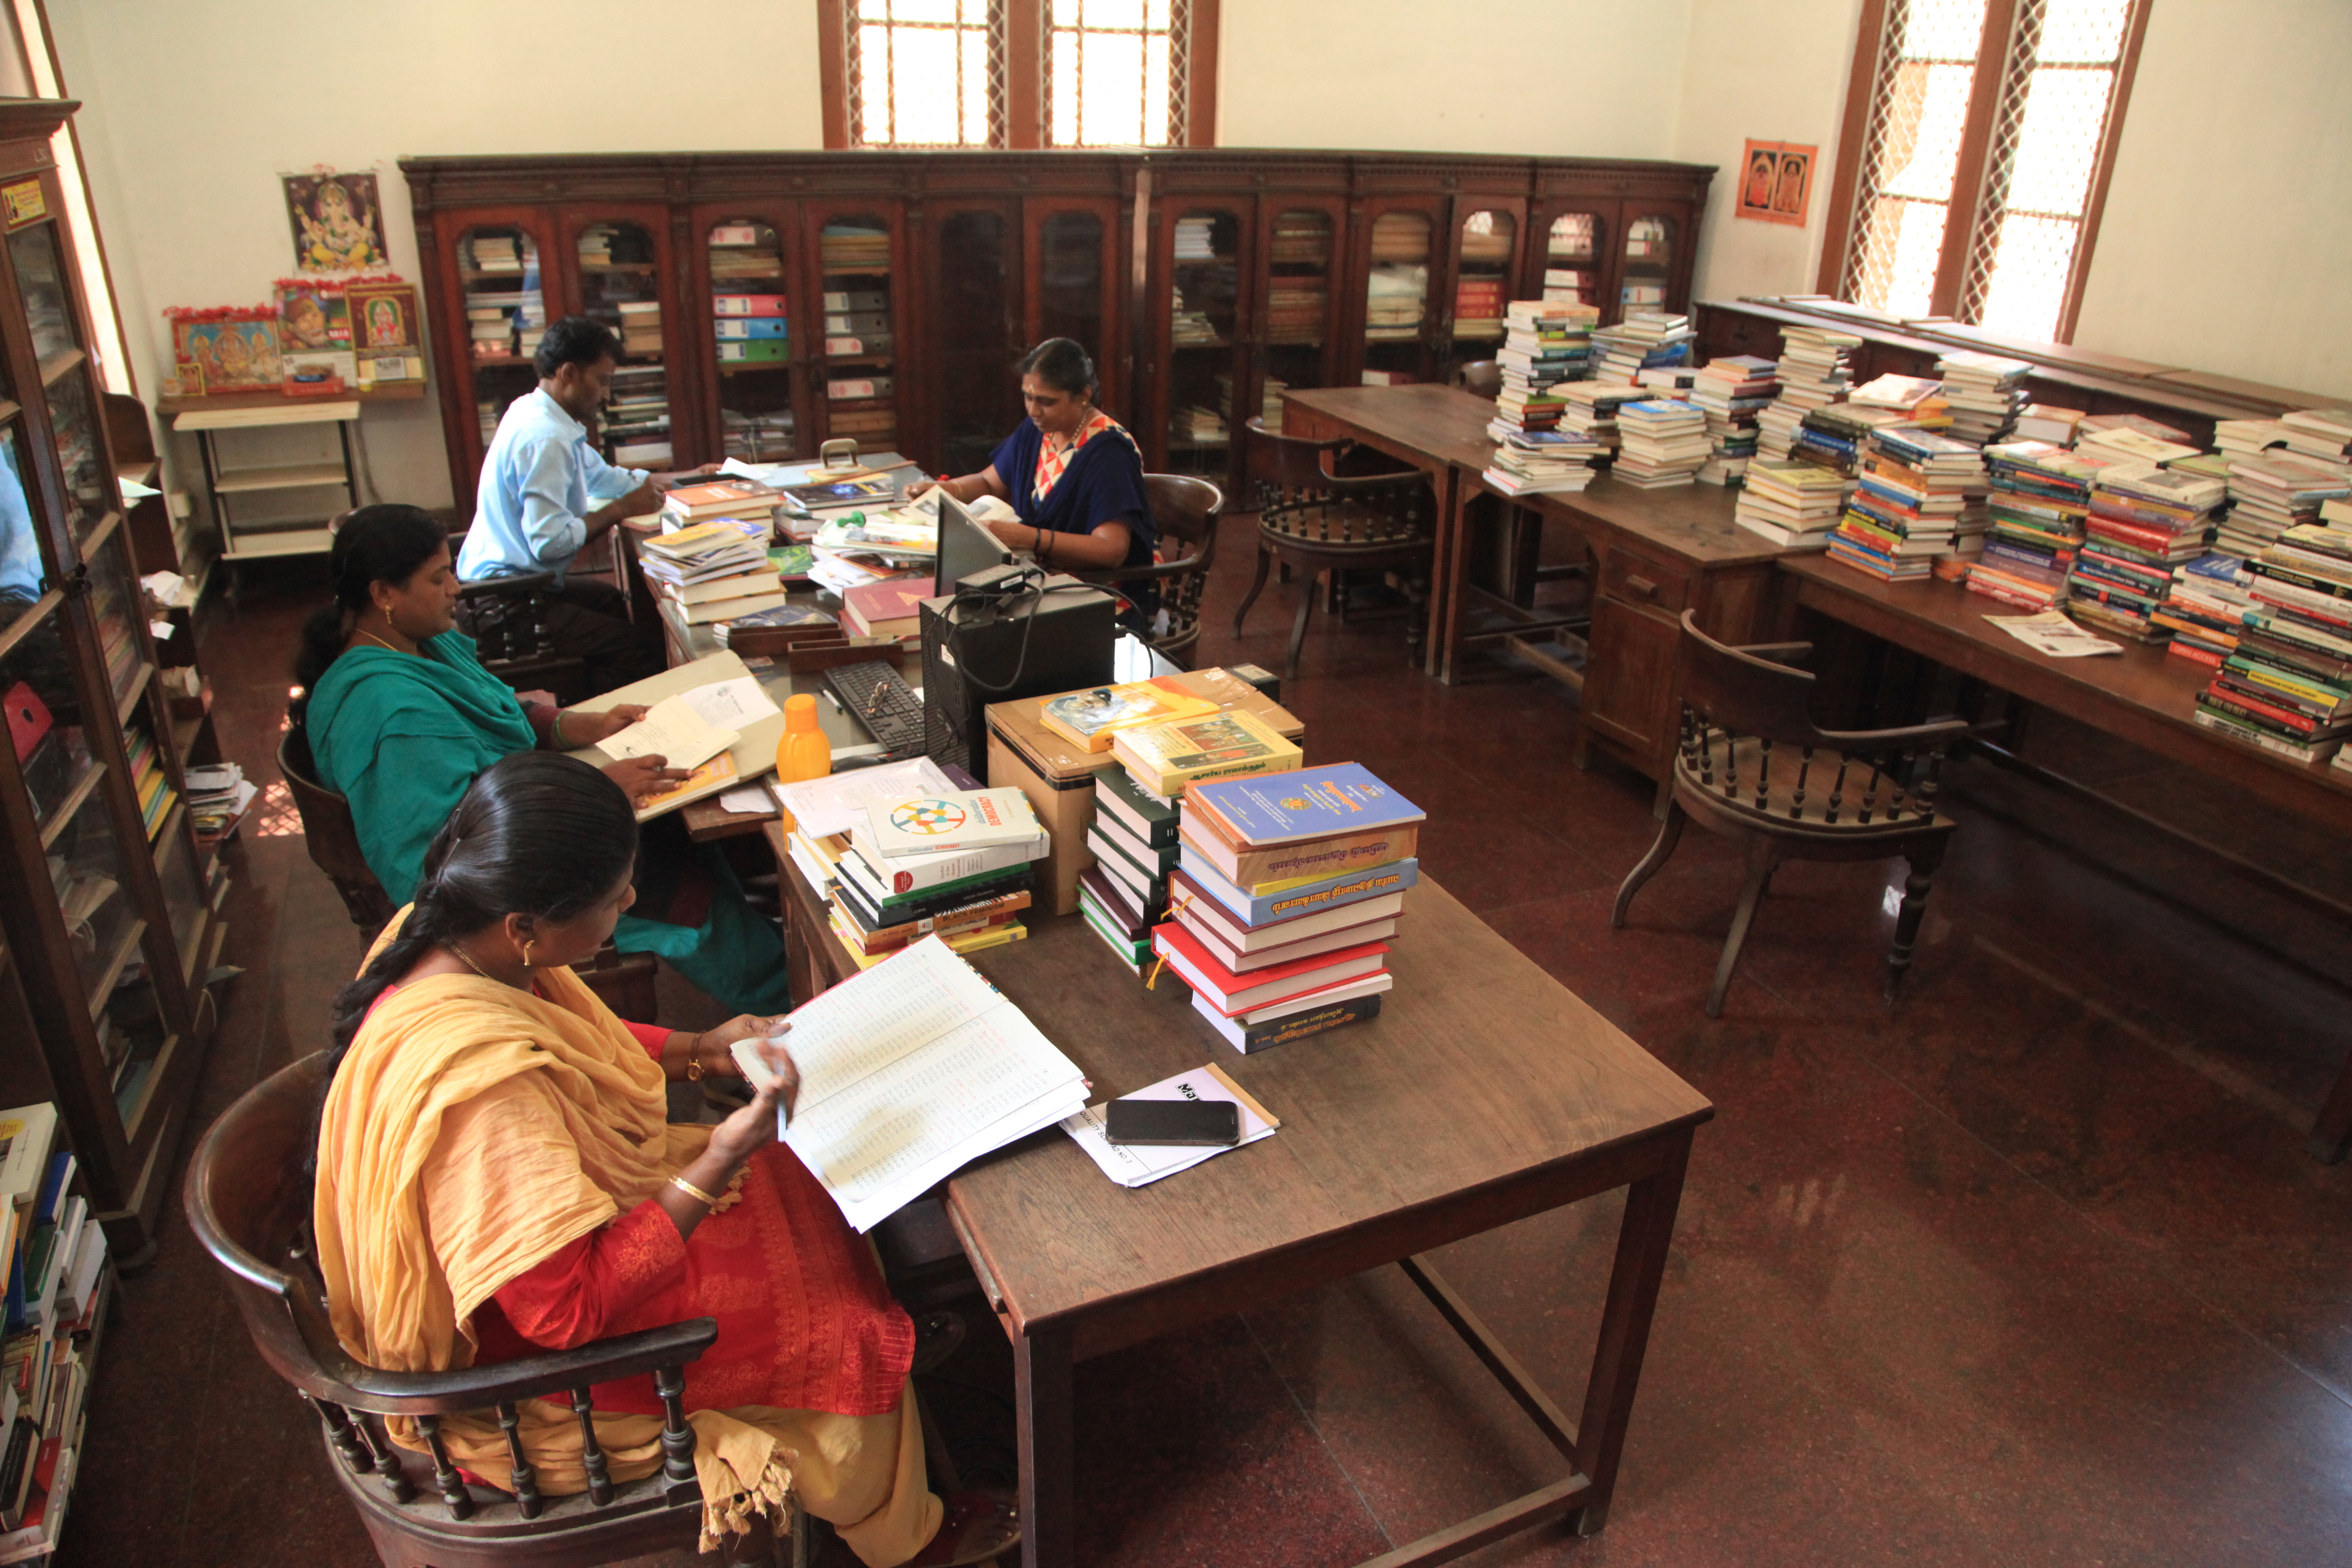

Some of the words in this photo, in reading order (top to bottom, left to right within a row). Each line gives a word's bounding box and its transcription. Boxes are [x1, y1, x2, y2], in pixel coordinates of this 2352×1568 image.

[2174, 645, 2192, 656] OPEN
[2193, 651, 2216, 664] ACCESS
[969, 799, 986, 824] deliberative
[977, 797, 1002, 826] DEMOCRACY
[1331, 878, 1375, 900] திருமொழி
[1375, 874, 1400, 888] பெரிய
[943, 911, 968, 922] BLACK
[970, 903, 1005, 915] FEMINISM
[1080, 1111, 1101, 1131] QUALITY
[1108, 1142, 1120, 1152] AD
[1118, 1151, 1127, 1161] NO.
